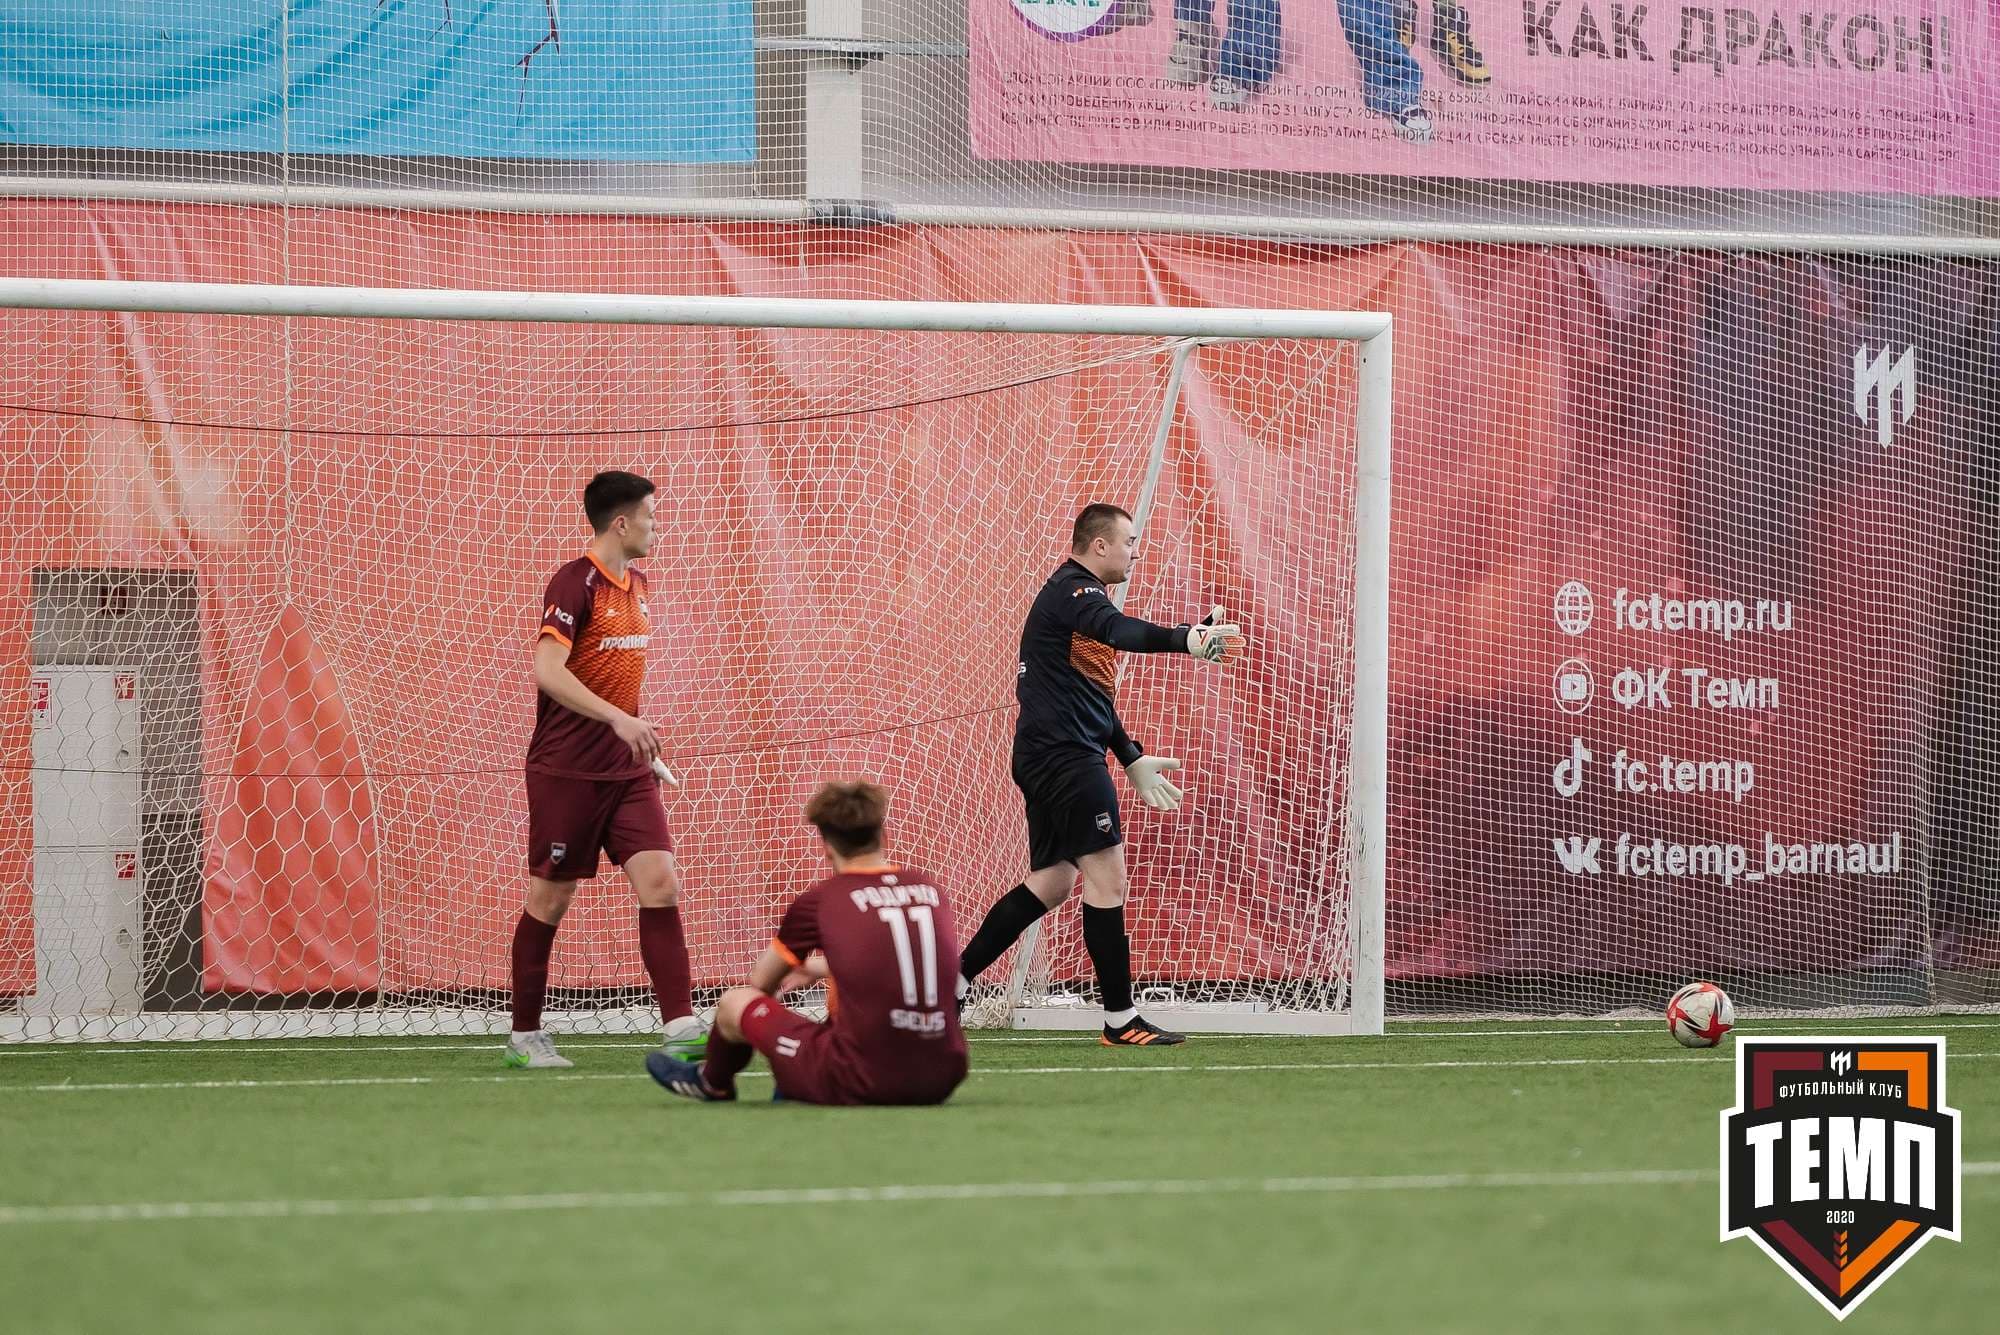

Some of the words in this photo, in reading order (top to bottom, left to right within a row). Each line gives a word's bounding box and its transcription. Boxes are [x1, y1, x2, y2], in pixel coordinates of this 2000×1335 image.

[1523, 0, 1654, 61] КАК
[1670, 5, 1953, 78] ДРАКОН!
[1067, 74, 1112, 87] АКЦИИ
[1115, 76, 1147, 89] ООО
[1314, 85, 1347, 99] ОГРН
[1261, 103, 1281, 116] ПО
[1612, 587, 1793, 641] fctemp.ru
[1612, 666, 1672, 711] ФК
[1682, 668, 1780, 709] Темп
[1612, 749, 1755, 801] fc.temp
[1614, 832, 1901, 886] fctemp_barnaul
[877, 905, 938, 1008] 11
